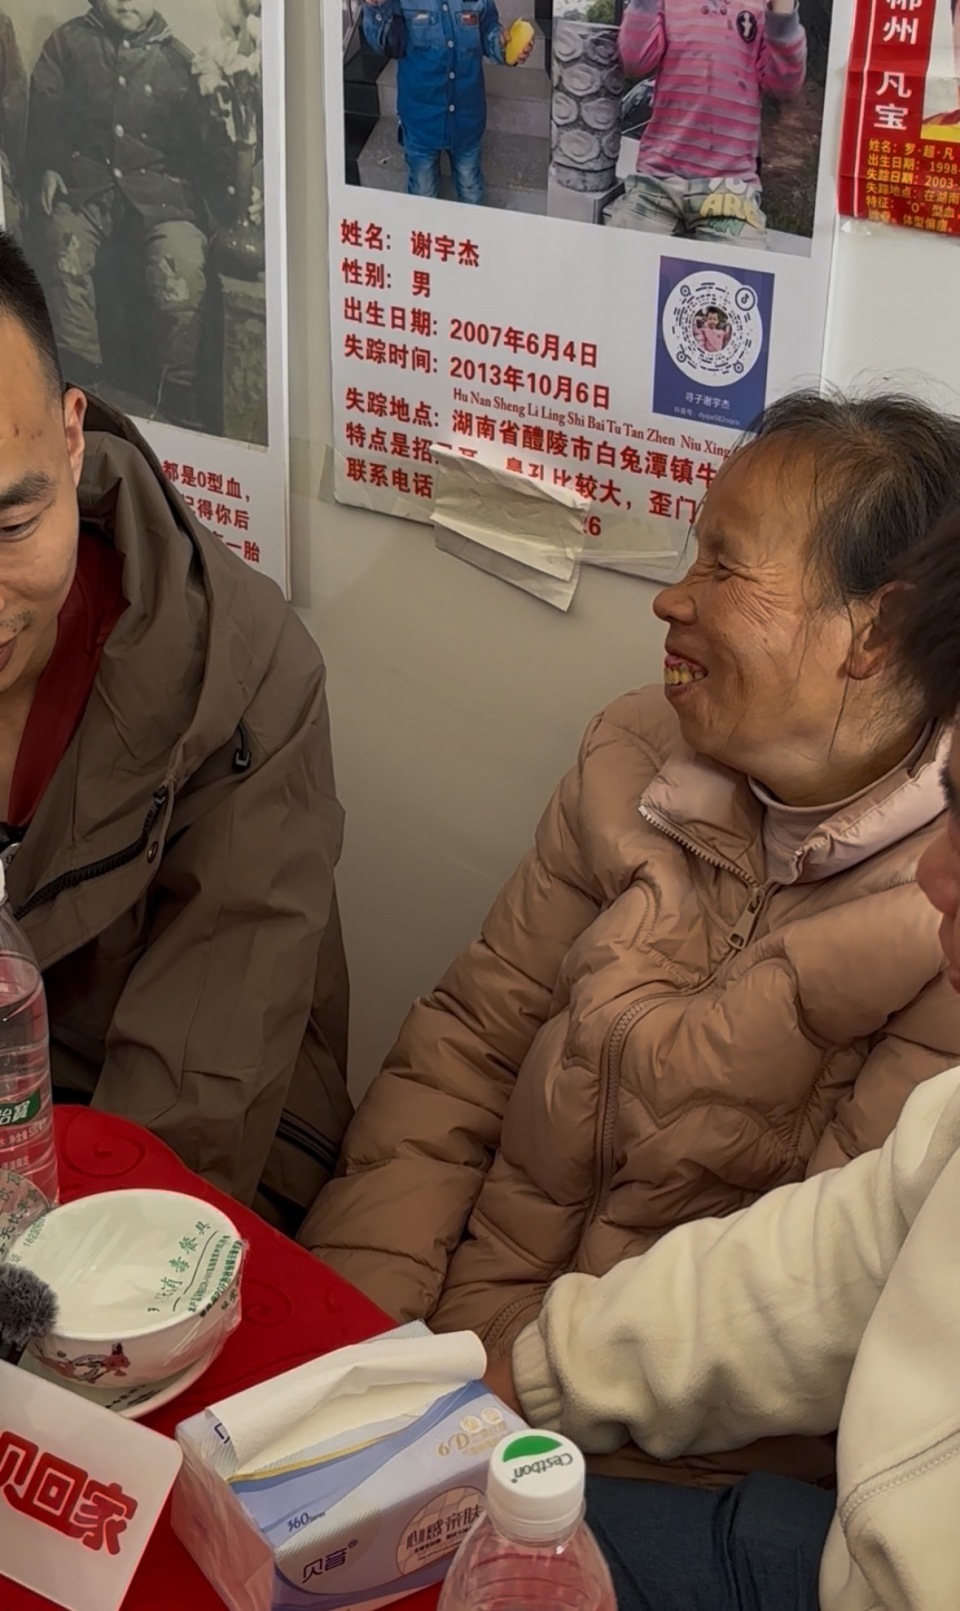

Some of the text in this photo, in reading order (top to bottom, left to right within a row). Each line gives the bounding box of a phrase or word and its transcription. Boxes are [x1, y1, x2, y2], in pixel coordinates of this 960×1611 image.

[873, 70, 913, 131] 凡宝
[867, 153, 920, 171] 出生日期：
[868, 137, 897, 154] 姓名：
[866, 167, 919, 186] 失踪日期：
[866, 182, 917, 199] 失踪地点：
[866, 195, 895, 210] 特征：
[340, 218, 481, 268] 姓名： 谢宇杰
[341, 257, 432, 298] 性别： 男
[343, 296, 599, 369] 出生日期： 2007年6月4日
[343, 334, 611, 411] 失踪时间： 2013年10月6日
[345, 386, 717, 489] 失踪地点： 湖南省醴陵市白兔潭镇牛
[453, 387, 730, 459] Hu Nan Sheng Li Ling Shi Bai Tu Tan Zhen Niu Xing
[346, 456, 434, 499] 联系电话
